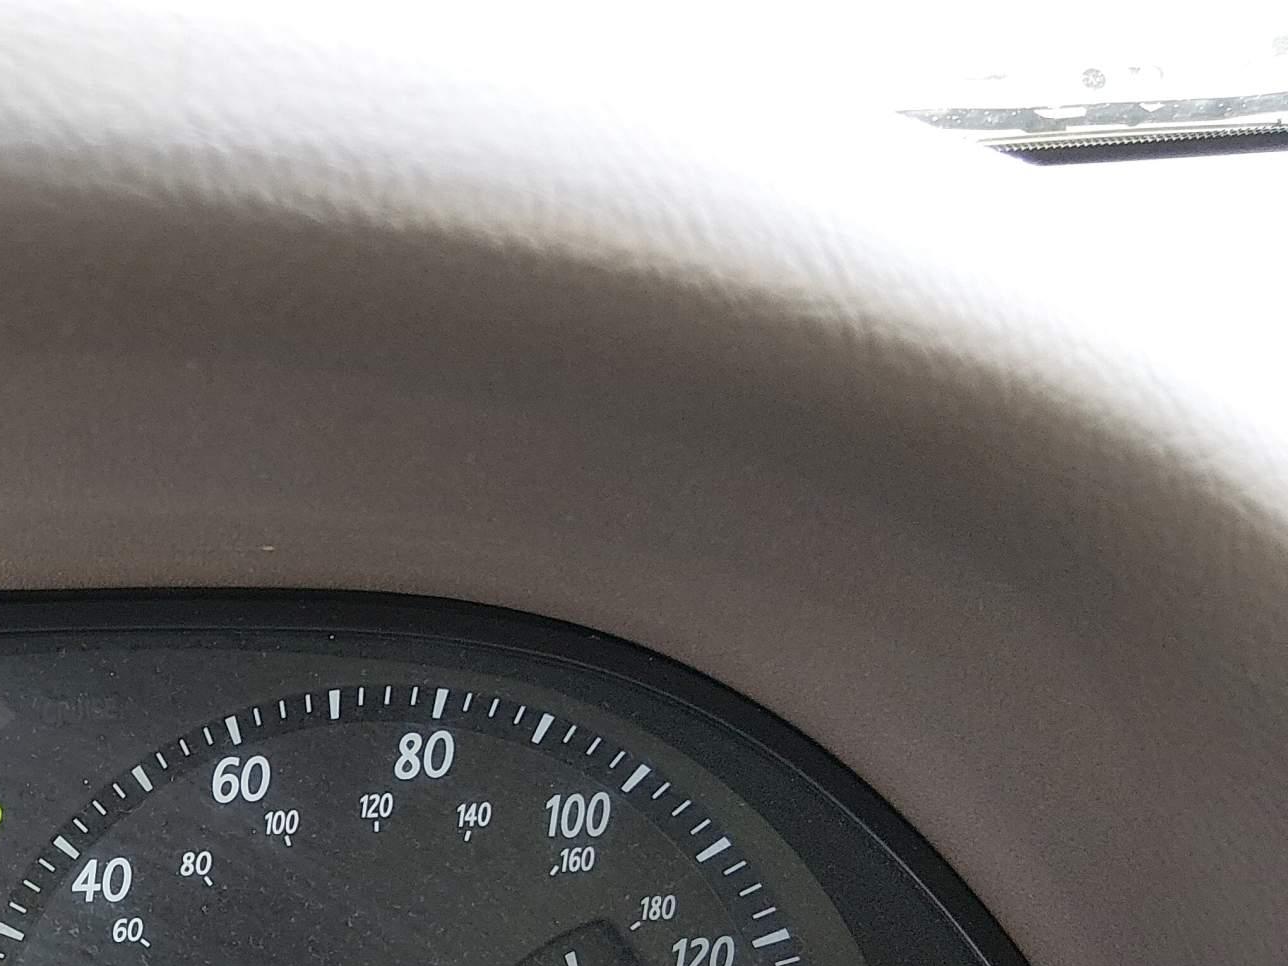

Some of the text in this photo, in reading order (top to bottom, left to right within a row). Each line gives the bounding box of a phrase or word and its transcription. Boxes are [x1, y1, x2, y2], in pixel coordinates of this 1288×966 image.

[395, 731, 454, 779] 80
[213, 756, 270, 803] 60
[360, 793, 393, 818] 120
[458, 802, 491, 827] 140
[546, 792, 610, 838] 100
[265, 810, 299, 834] 100
[181, 851, 211, 876] 80
[561, 847, 595, 872] 160
[71, 857, 132, 903] 40
[641, 895, 676, 920] 180
[113, 918, 143, 942] 60
